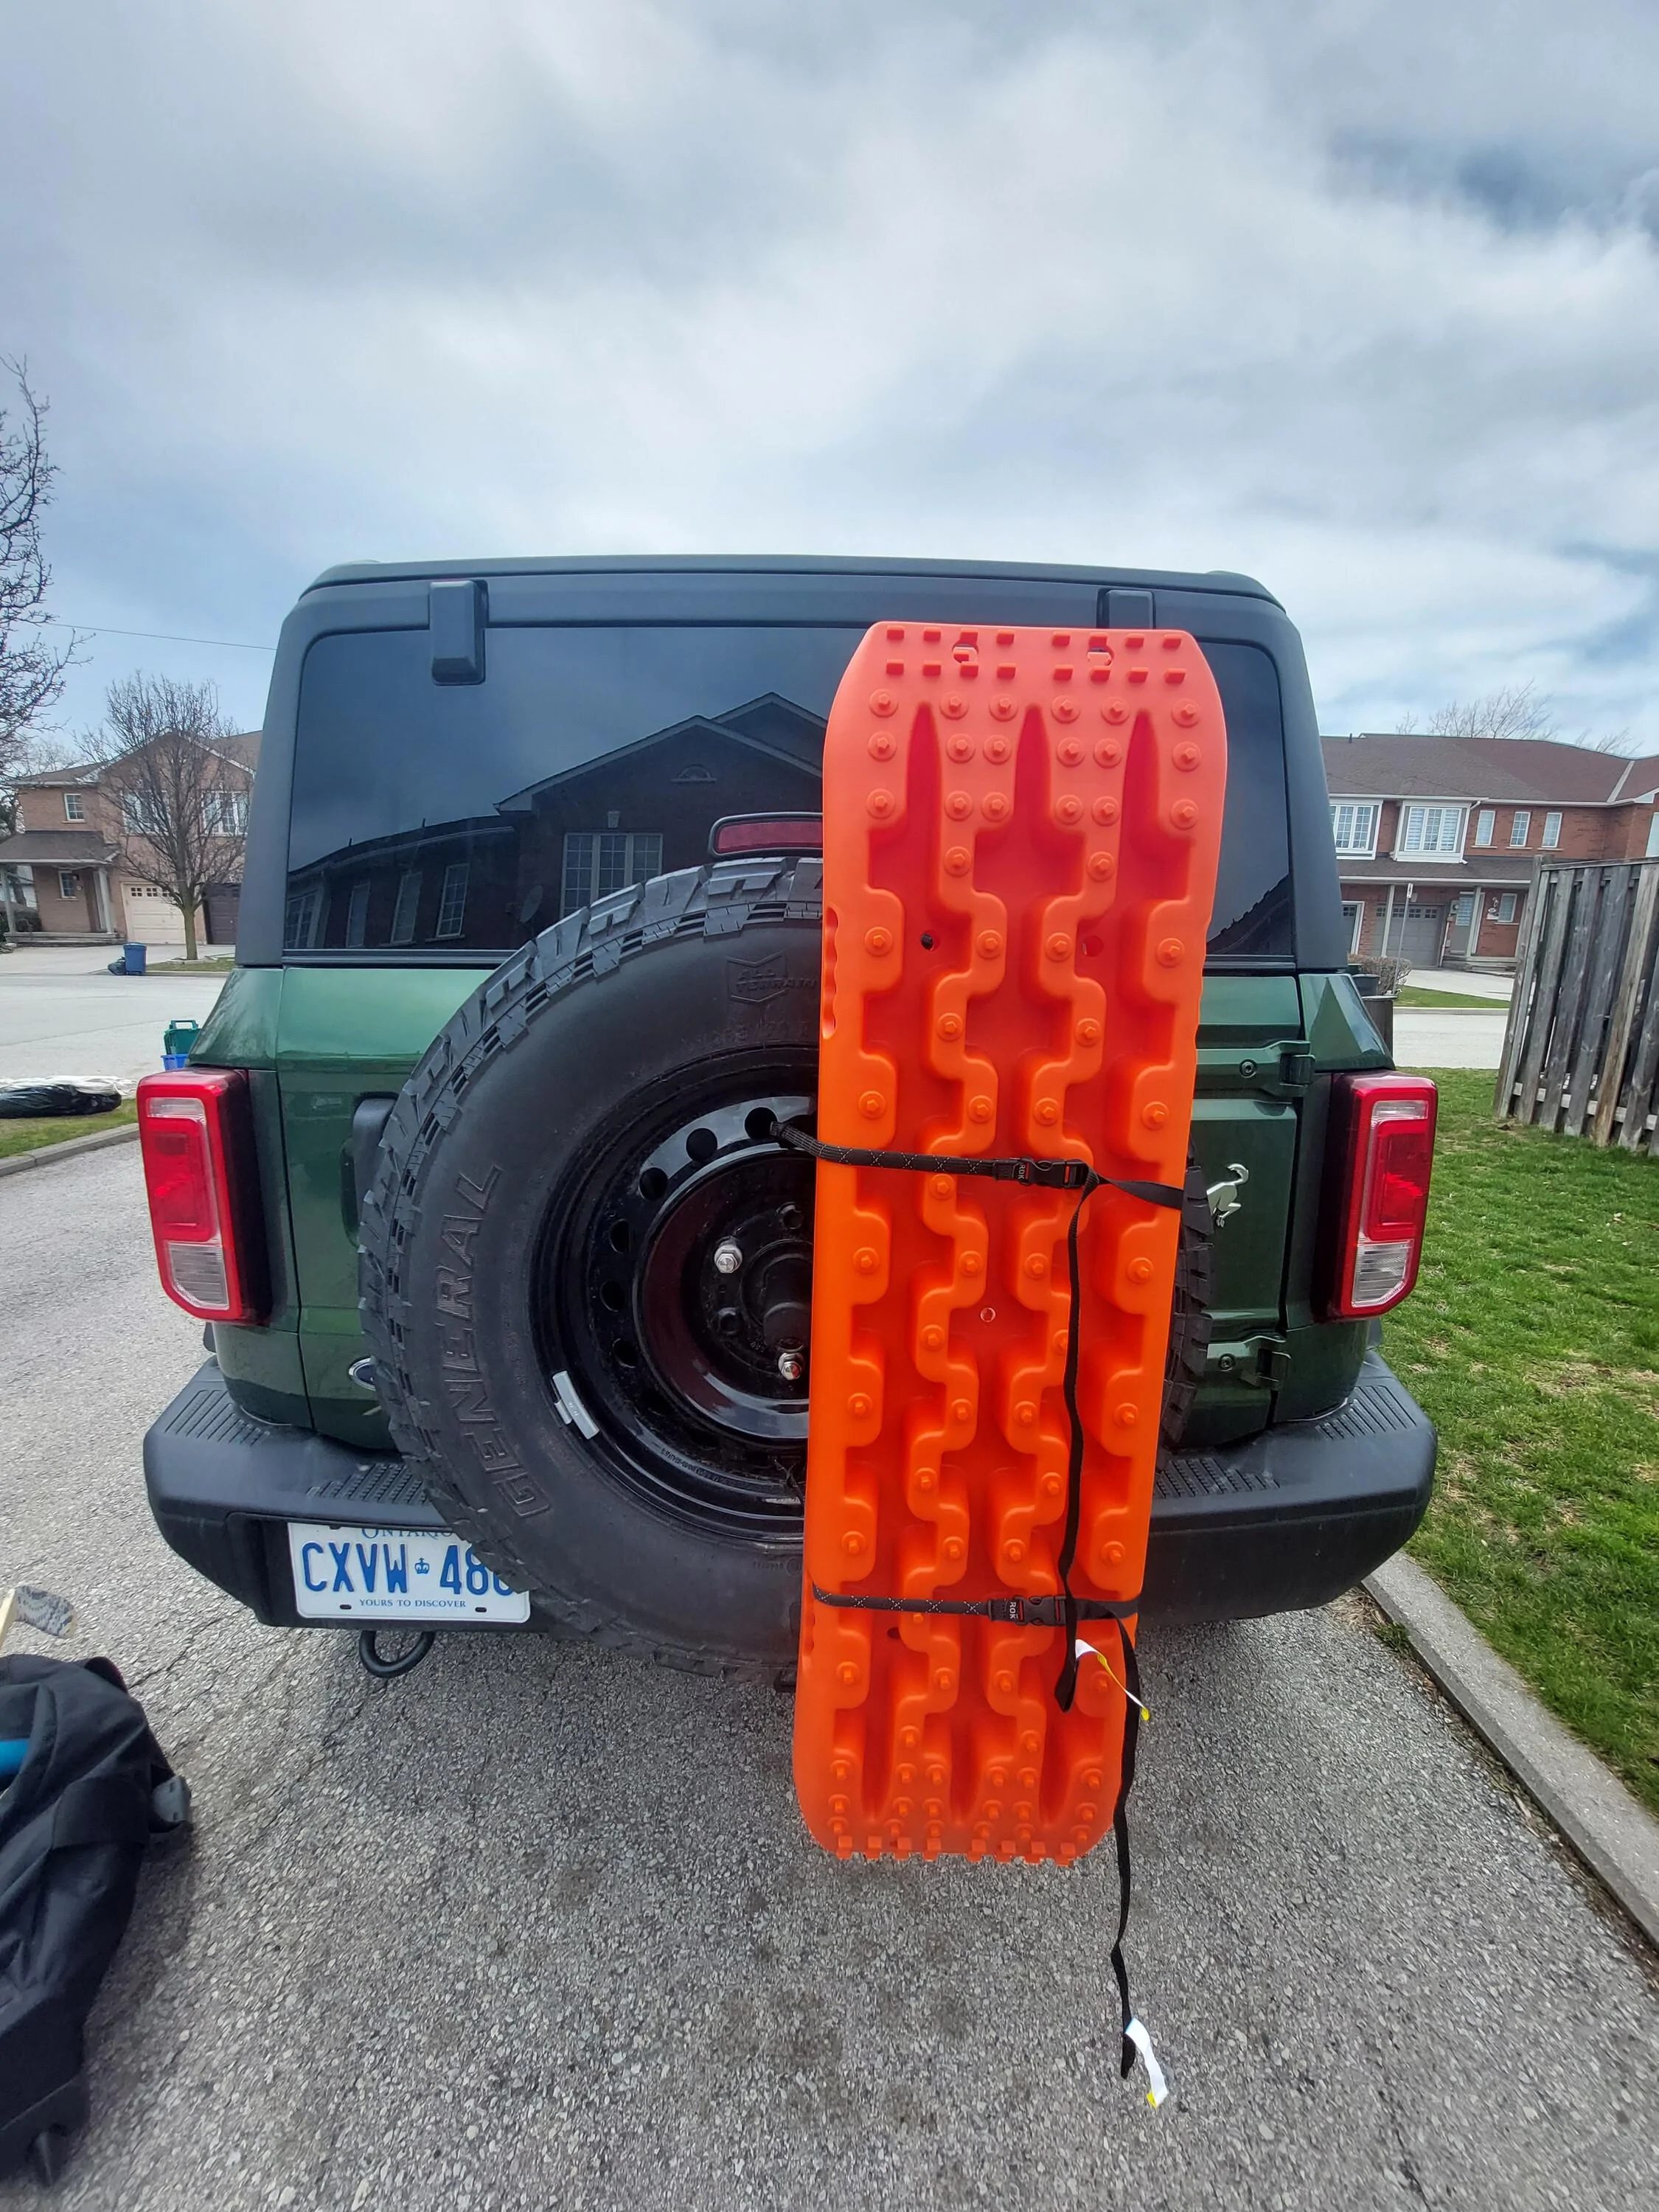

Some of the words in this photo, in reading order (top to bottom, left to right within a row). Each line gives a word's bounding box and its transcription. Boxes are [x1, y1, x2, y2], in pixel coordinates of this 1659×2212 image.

[1018, 1164, 1026, 1180] ROK
[437, 1164, 552, 1517] GENERAL
[302, 1542, 408, 1593] CXVW
[359, 1599, 393, 1607] YOURS
[397, 1599, 411, 1607] TO
[415, 1599, 466, 1607] DISCOVER
